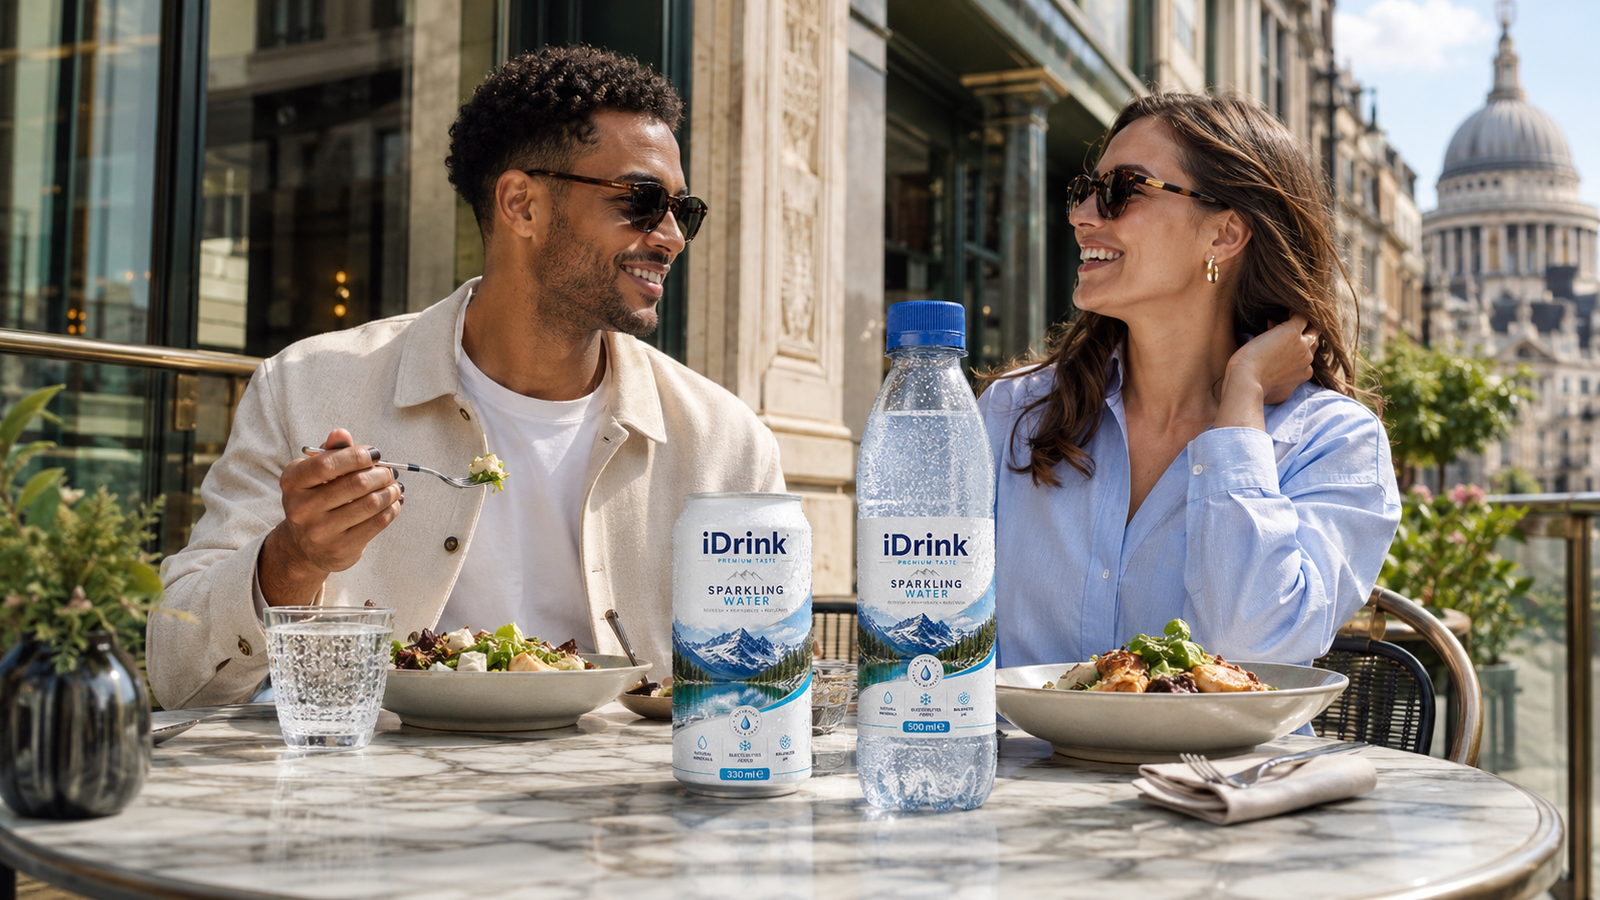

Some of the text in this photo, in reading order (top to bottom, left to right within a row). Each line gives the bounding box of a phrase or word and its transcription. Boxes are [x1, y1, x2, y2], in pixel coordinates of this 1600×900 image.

[702, 531, 787, 555] iDrink
[883, 532, 968, 557] iDrink
[891, 579, 962, 589] SPARKLING
[708, 585, 784, 595] SPARKLING
[905, 589, 948, 598] WATER
[724, 596, 770, 606] WATER
[907, 722, 924, 731] 500
[726, 770, 744, 779] 330
